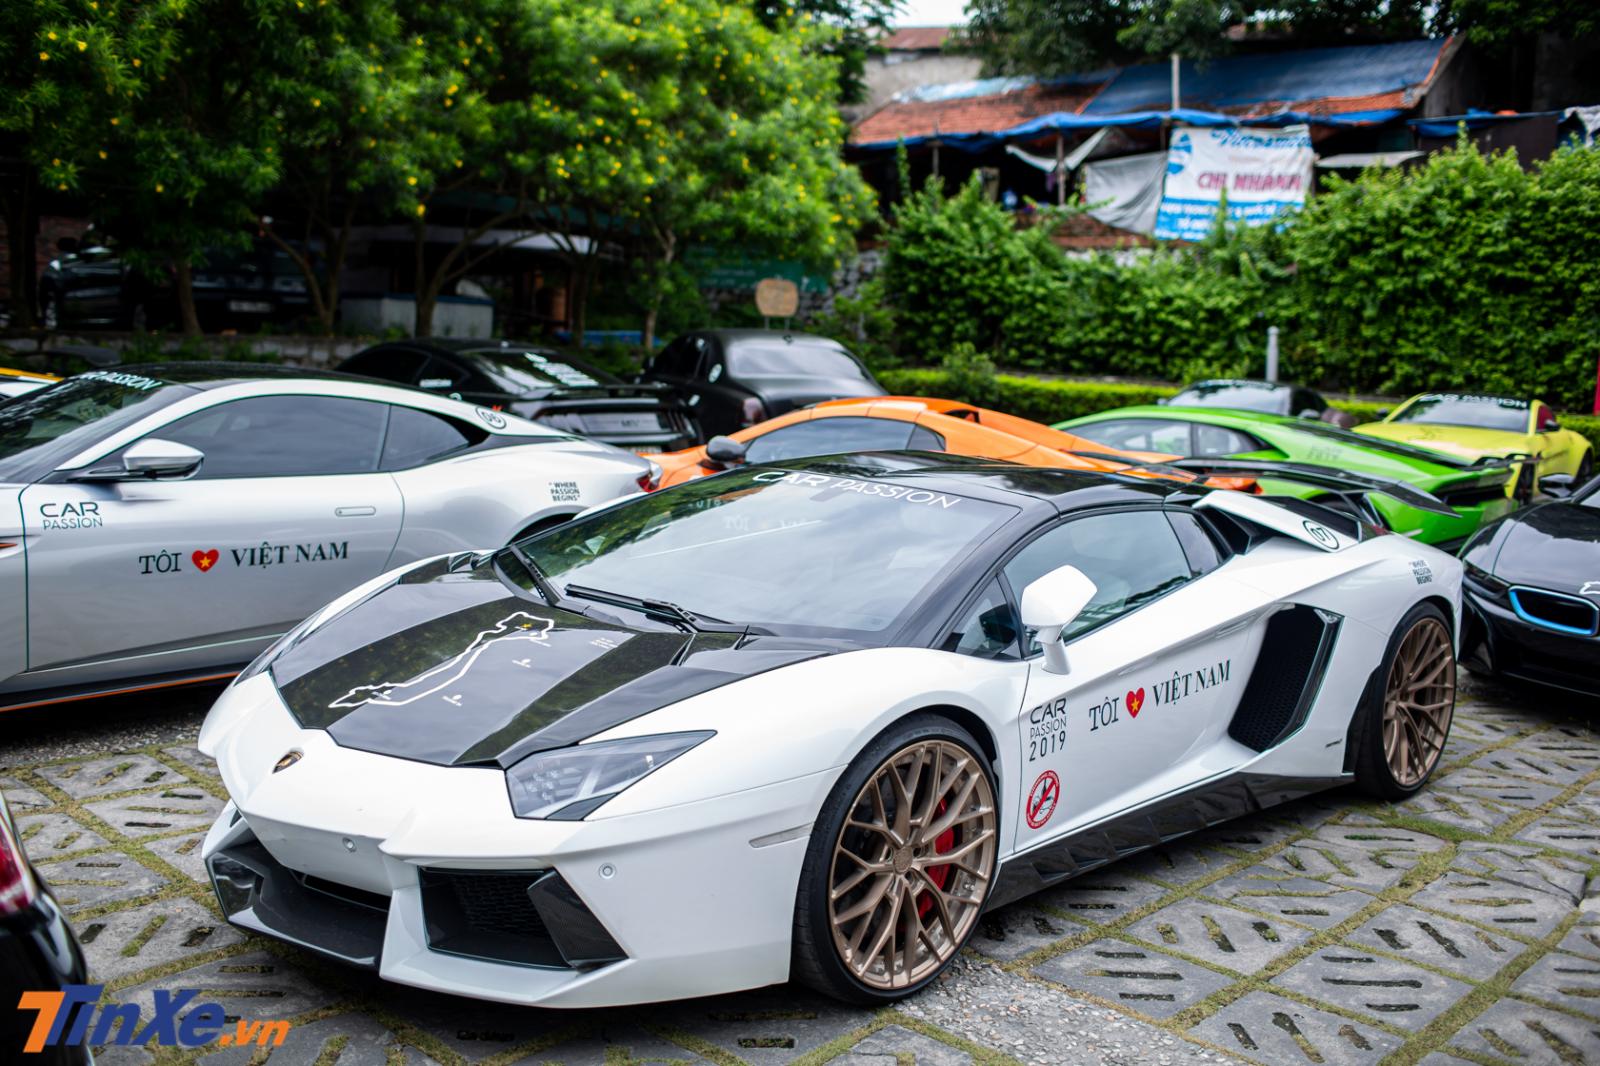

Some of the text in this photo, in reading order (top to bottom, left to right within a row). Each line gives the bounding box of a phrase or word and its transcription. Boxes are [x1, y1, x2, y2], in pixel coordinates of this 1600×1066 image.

[752, 471, 960, 509] CAR PASSION
[40, 501, 100, 518] CAR
[42, 517, 103, 530] PASSION
[1310, 527, 1331, 542] 07
[139, 541, 349, 574] TÔI VIỆT NAM
[1088, 659, 1231, 732] TÔI VIỆT NAM
[1029, 697, 1067, 725] CAR
[1029, 716, 1067, 740] PASSION
[1029, 730, 1067, 762] 2019
